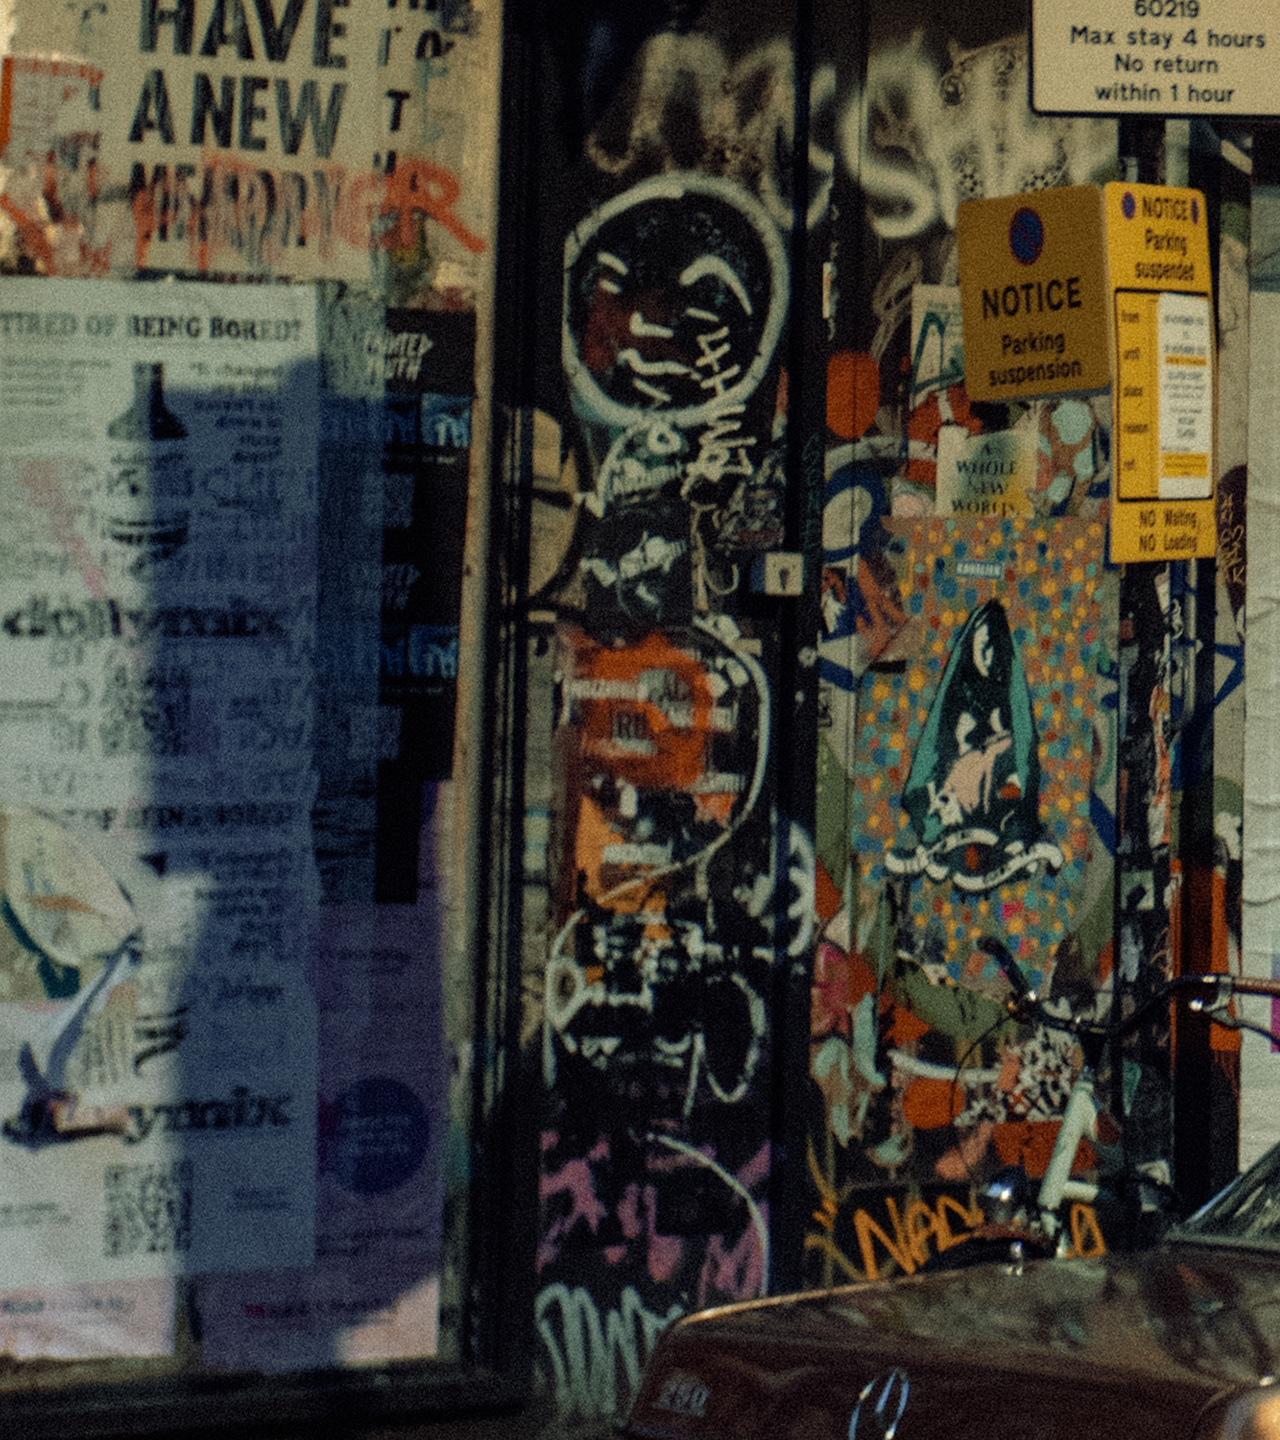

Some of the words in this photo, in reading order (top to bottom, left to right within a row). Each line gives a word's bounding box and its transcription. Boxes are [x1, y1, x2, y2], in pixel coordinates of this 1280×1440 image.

[1070, 25, 1116, 45] Max
[1126, 28, 1174, 51] stay
[1182, 28, 1198, 46] 4
[1207, 28, 1267, 50] hours
[1114, 53, 1145, 73] No
[1153, 55, 1220, 74] return
[1094, 82, 1162, 102] within
[1170, 82, 1179, 102] 1
[1187, 83, 1235, 104] hour
[128, 68, 176, 145] A
[189, 71, 349, 159] NEW
[1142, 196, 1188, 222] NOTICE
[1144, 228, 1188, 256] Parking
[1135, 260, 1195, 282] suspended
[981, 277, 1083, 319] NOTICE
[128, 315, 202, 339] BEING
[1001, 330, 1066, 357] Parking
[988, 358, 1083, 387] suspension
[1139, 508, 1157, 528] NO
[1139, 534, 1157, 553] NO
